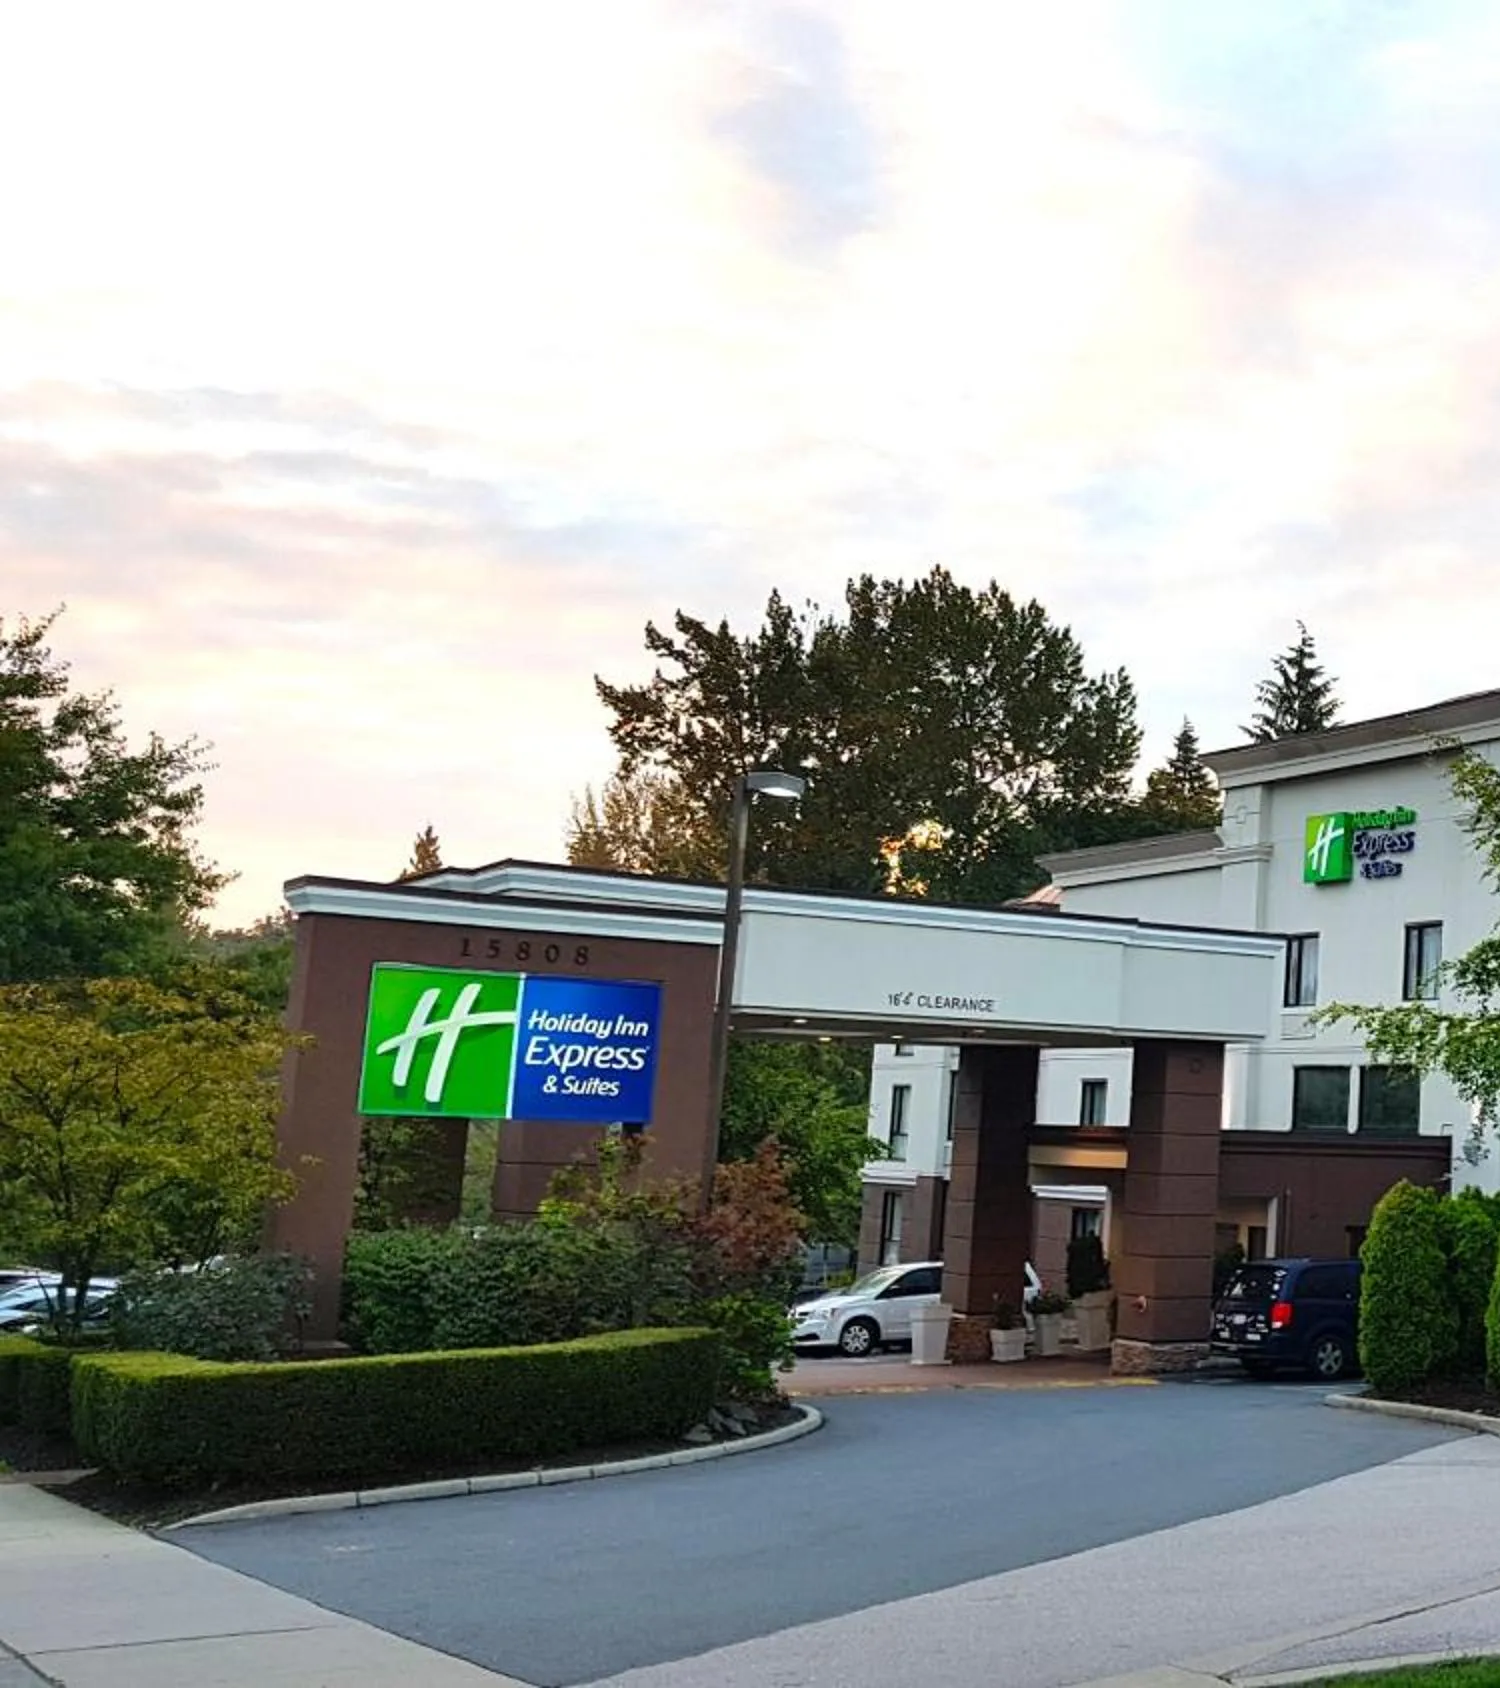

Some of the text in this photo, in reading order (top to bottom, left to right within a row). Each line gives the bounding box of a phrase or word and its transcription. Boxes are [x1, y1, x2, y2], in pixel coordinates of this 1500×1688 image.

[1353, 831, 1415, 860] Express
[460, 938, 590, 966] 15808
[917, 995, 994, 1013] CLEARANCE
[528, 1009, 649, 1039] Holiday Inn
[524, 1036, 648, 1073] Express
[542, 1075, 620, 1097] & Suites
